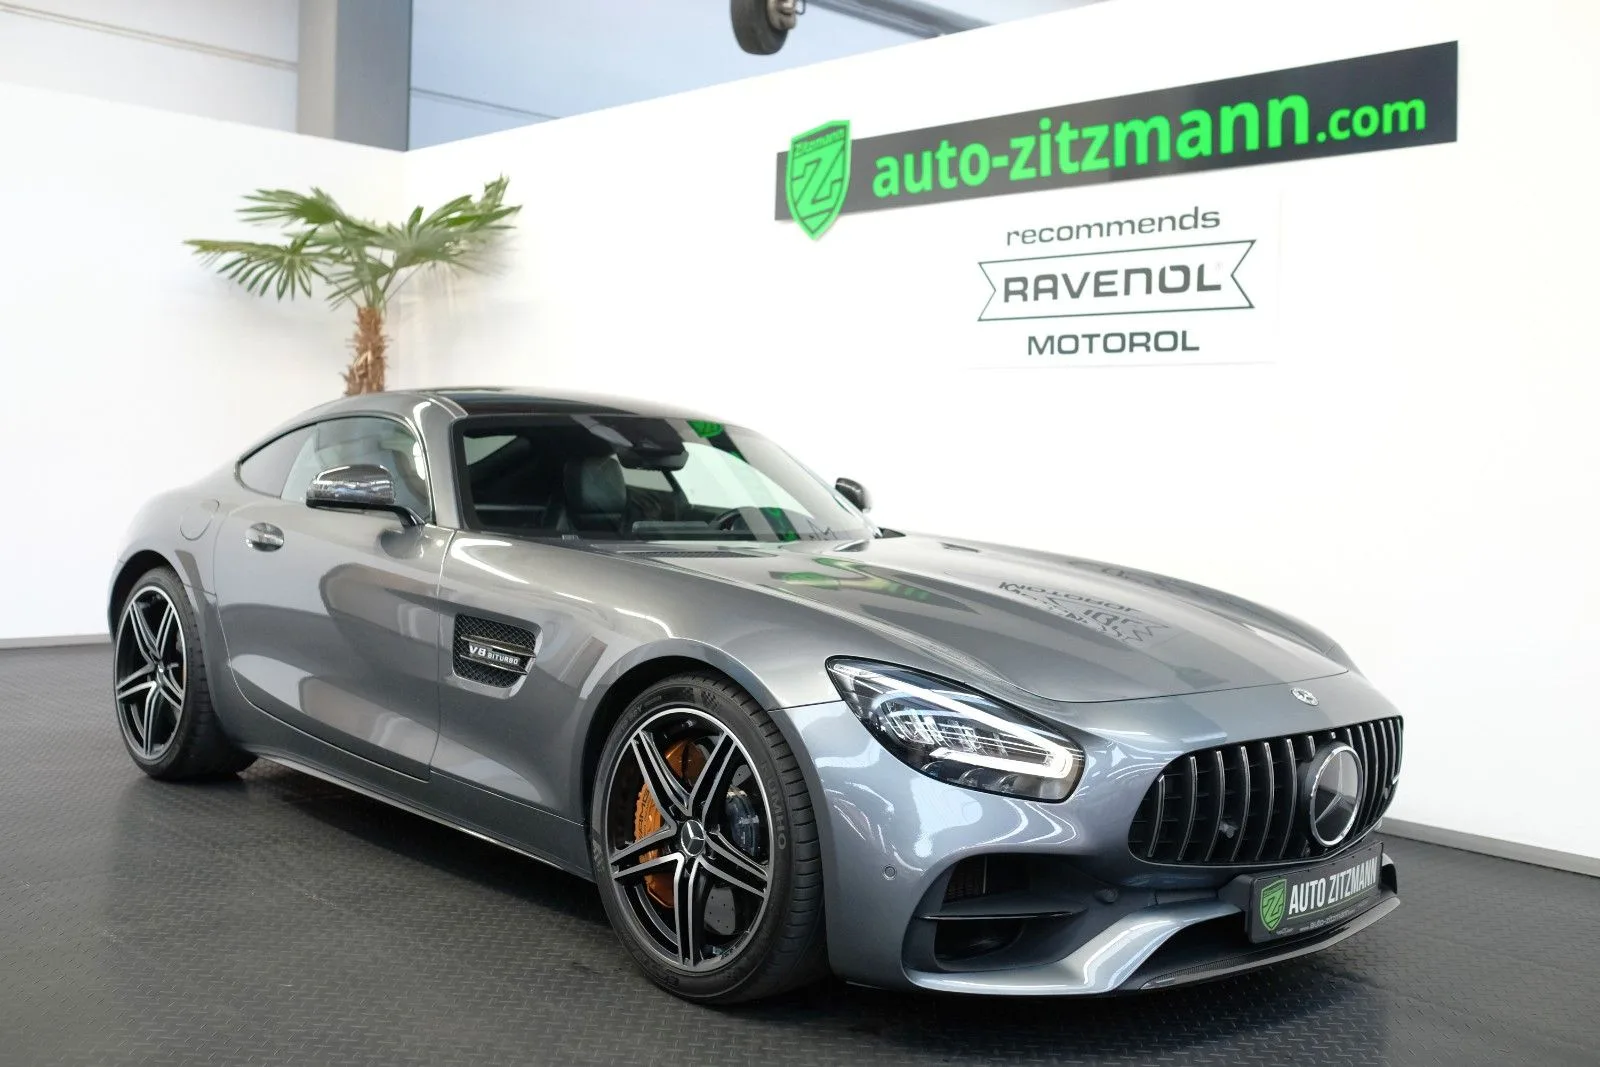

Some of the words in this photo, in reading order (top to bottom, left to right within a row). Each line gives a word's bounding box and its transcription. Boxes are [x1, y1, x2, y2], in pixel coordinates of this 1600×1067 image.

[871, 92, 1428, 199] auto-zitzmann.com
[1007, 205, 1221, 246] recommends
[1003, 263, 1222, 303] RAVENOL
[1027, 330, 1200, 356] MOTOROL
[468, 644, 487, 657] V8
[487, 652, 519, 665] BITURBO
[1288, 877, 1327, 915] AUTO
[1327, 856, 1378, 904] ZITZMANN
